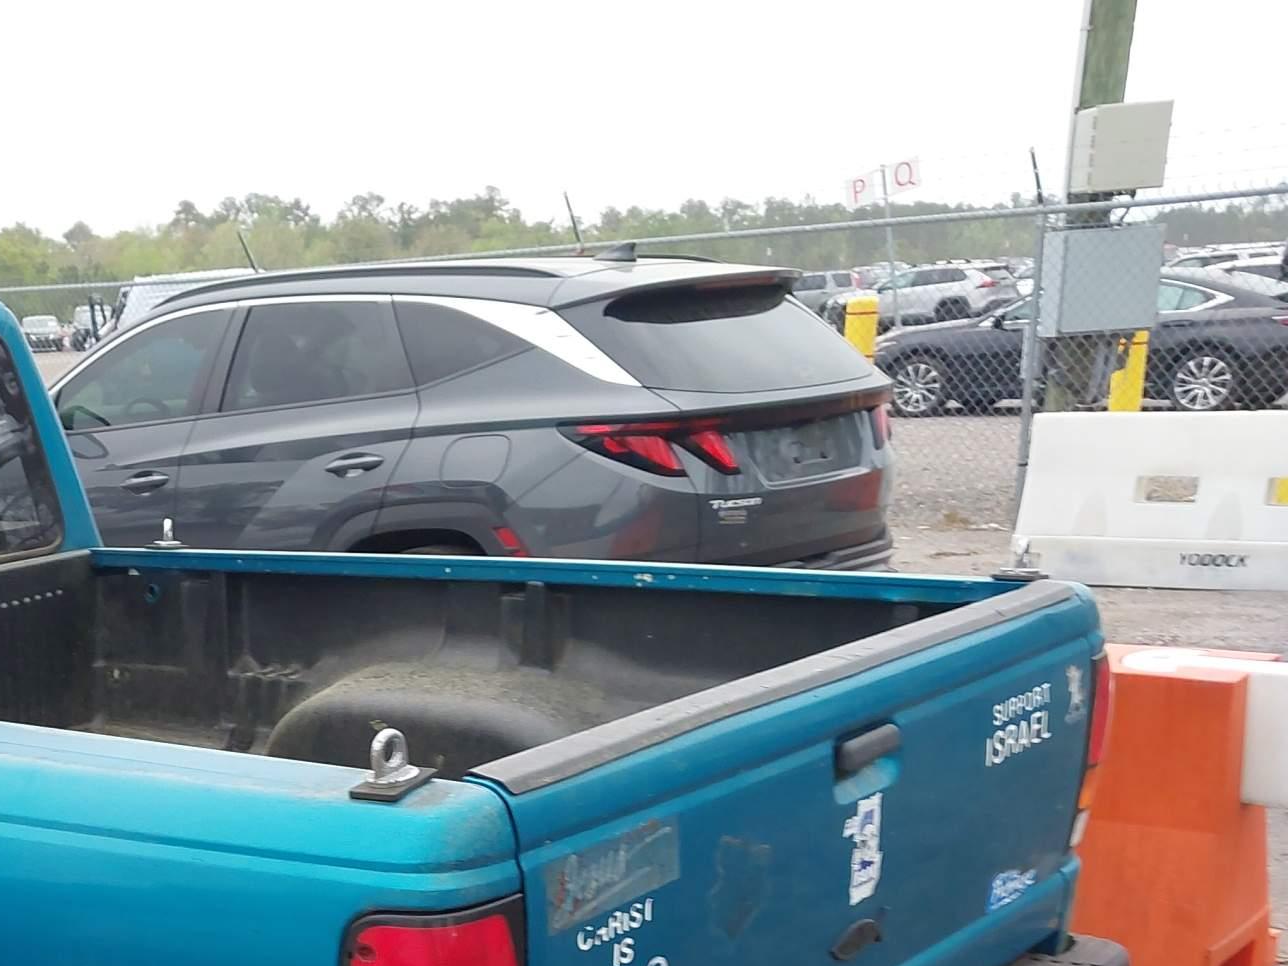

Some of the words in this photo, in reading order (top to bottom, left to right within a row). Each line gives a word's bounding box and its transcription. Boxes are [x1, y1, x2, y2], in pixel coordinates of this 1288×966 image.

[852, 178, 865, 204] P
[894, 162, 916, 186] Q
[992, 683, 1052, 726] SUPPORT
[985, 710, 1052, 767] ISRAEL
